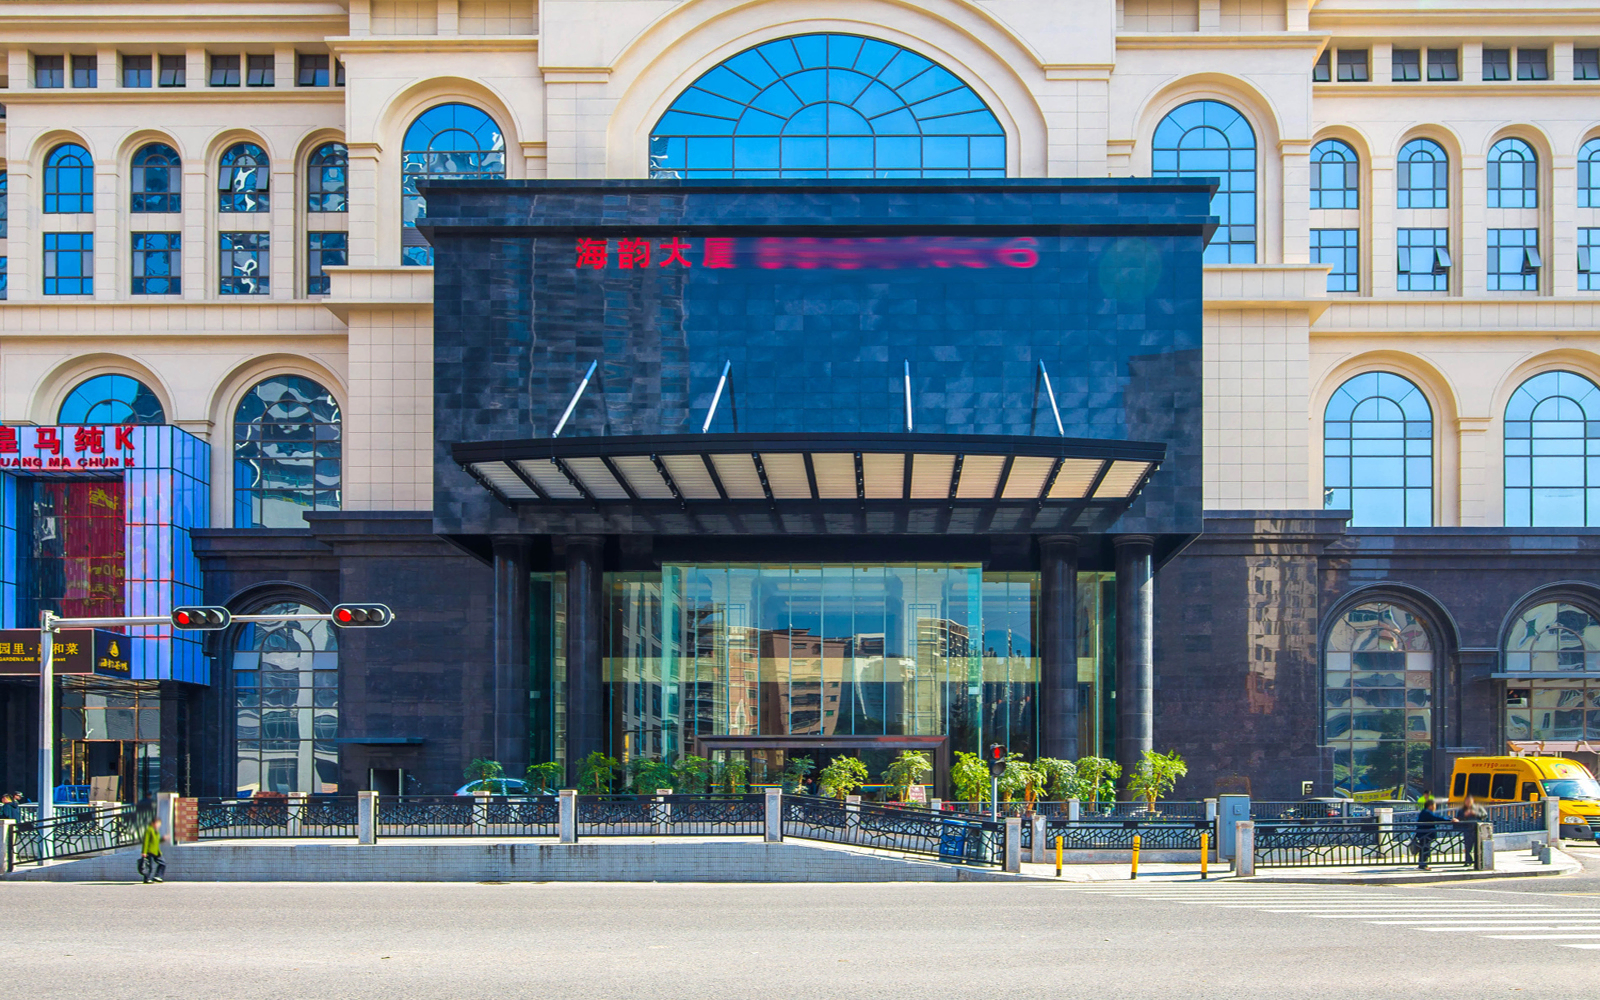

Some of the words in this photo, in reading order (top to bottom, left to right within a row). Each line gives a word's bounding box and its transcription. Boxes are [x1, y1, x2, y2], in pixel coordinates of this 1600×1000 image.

[0, 457, 43, 467] UANG
[48, 457, 71, 467] MA
[77, 457, 119, 467] CHUN
[124, 457, 135, 467] K
